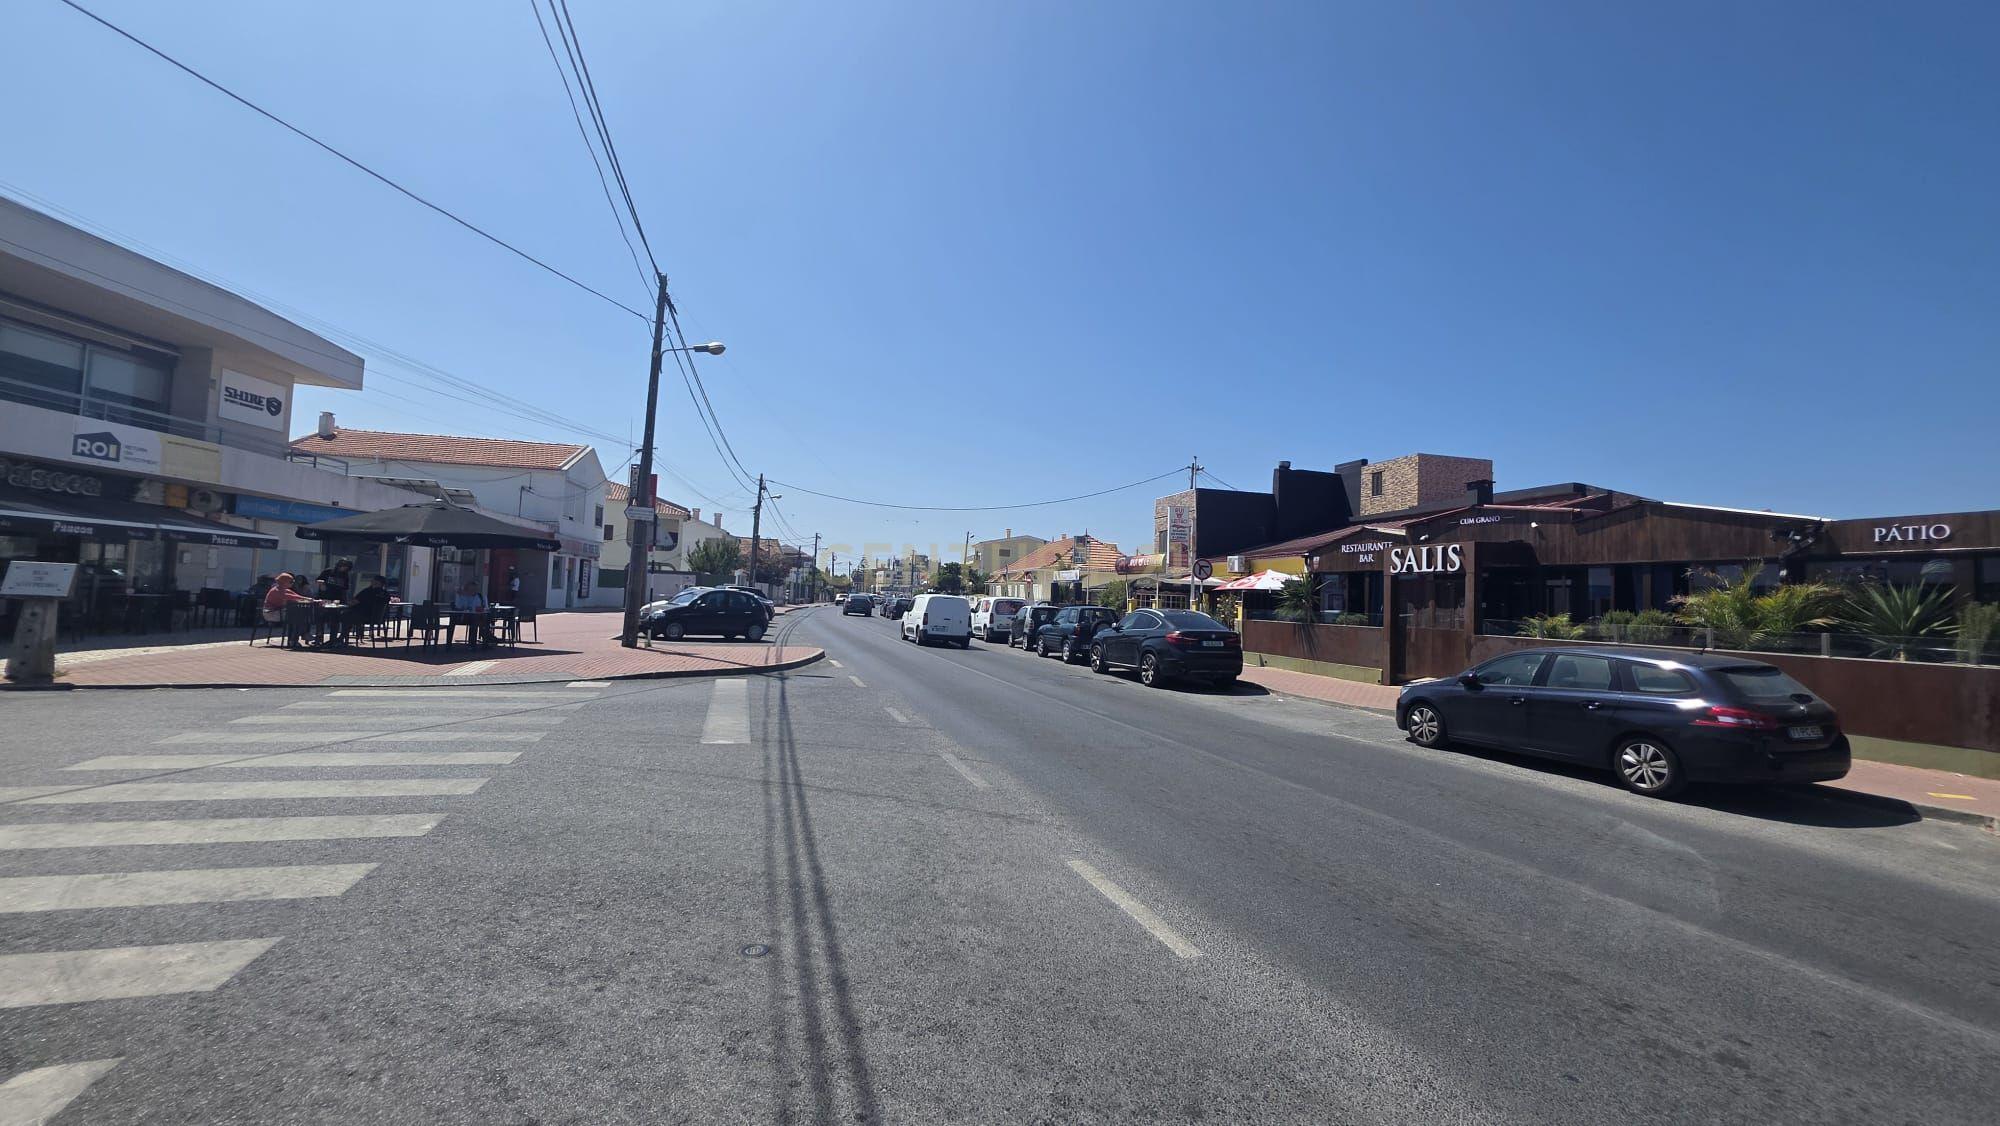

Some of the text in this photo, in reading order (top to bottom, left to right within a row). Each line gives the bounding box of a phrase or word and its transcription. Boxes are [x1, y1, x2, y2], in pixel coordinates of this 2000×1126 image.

[224, 386, 266, 407] SHIRE
[76, 438, 117, 459] ROI
[1475, 515, 1501, 524] GRANO
[1873, 523, 1951, 542] PÁTIO
[1341, 541, 1393, 553] RESTAURANTE
[1359, 553, 1374, 563] BAR
[1390, 543, 1462, 574] SALIS
